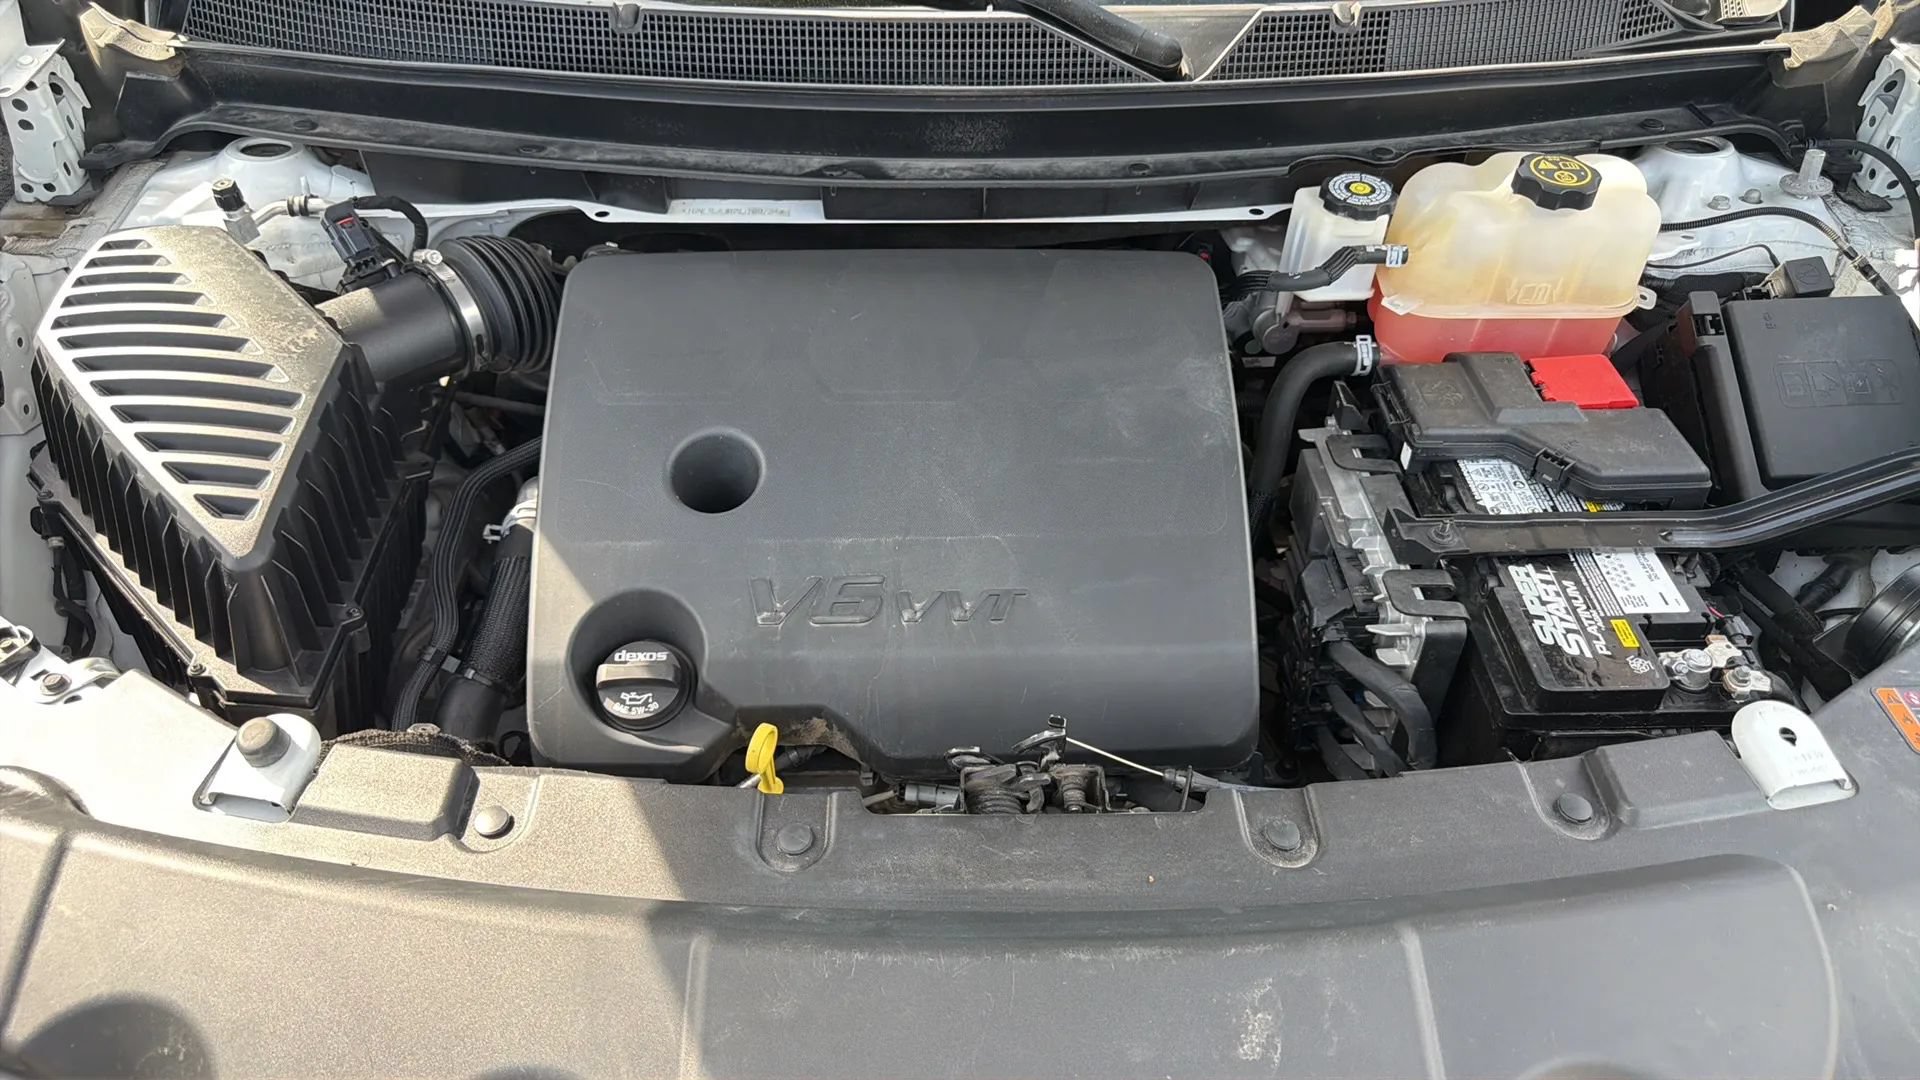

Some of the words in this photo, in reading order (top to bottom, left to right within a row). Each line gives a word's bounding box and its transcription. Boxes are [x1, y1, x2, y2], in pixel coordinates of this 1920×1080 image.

[751, 574, 885, 627] V6
[898, 588, 1029, 624] VVT
[1508, 565, 1555, 645] SUPER
[1525, 563, 1594, 658] START
[1561, 580, 1612, 656] PLATINUM
[613, 650, 670, 662] dexos
[630, 701, 660, 716] 5W-30
